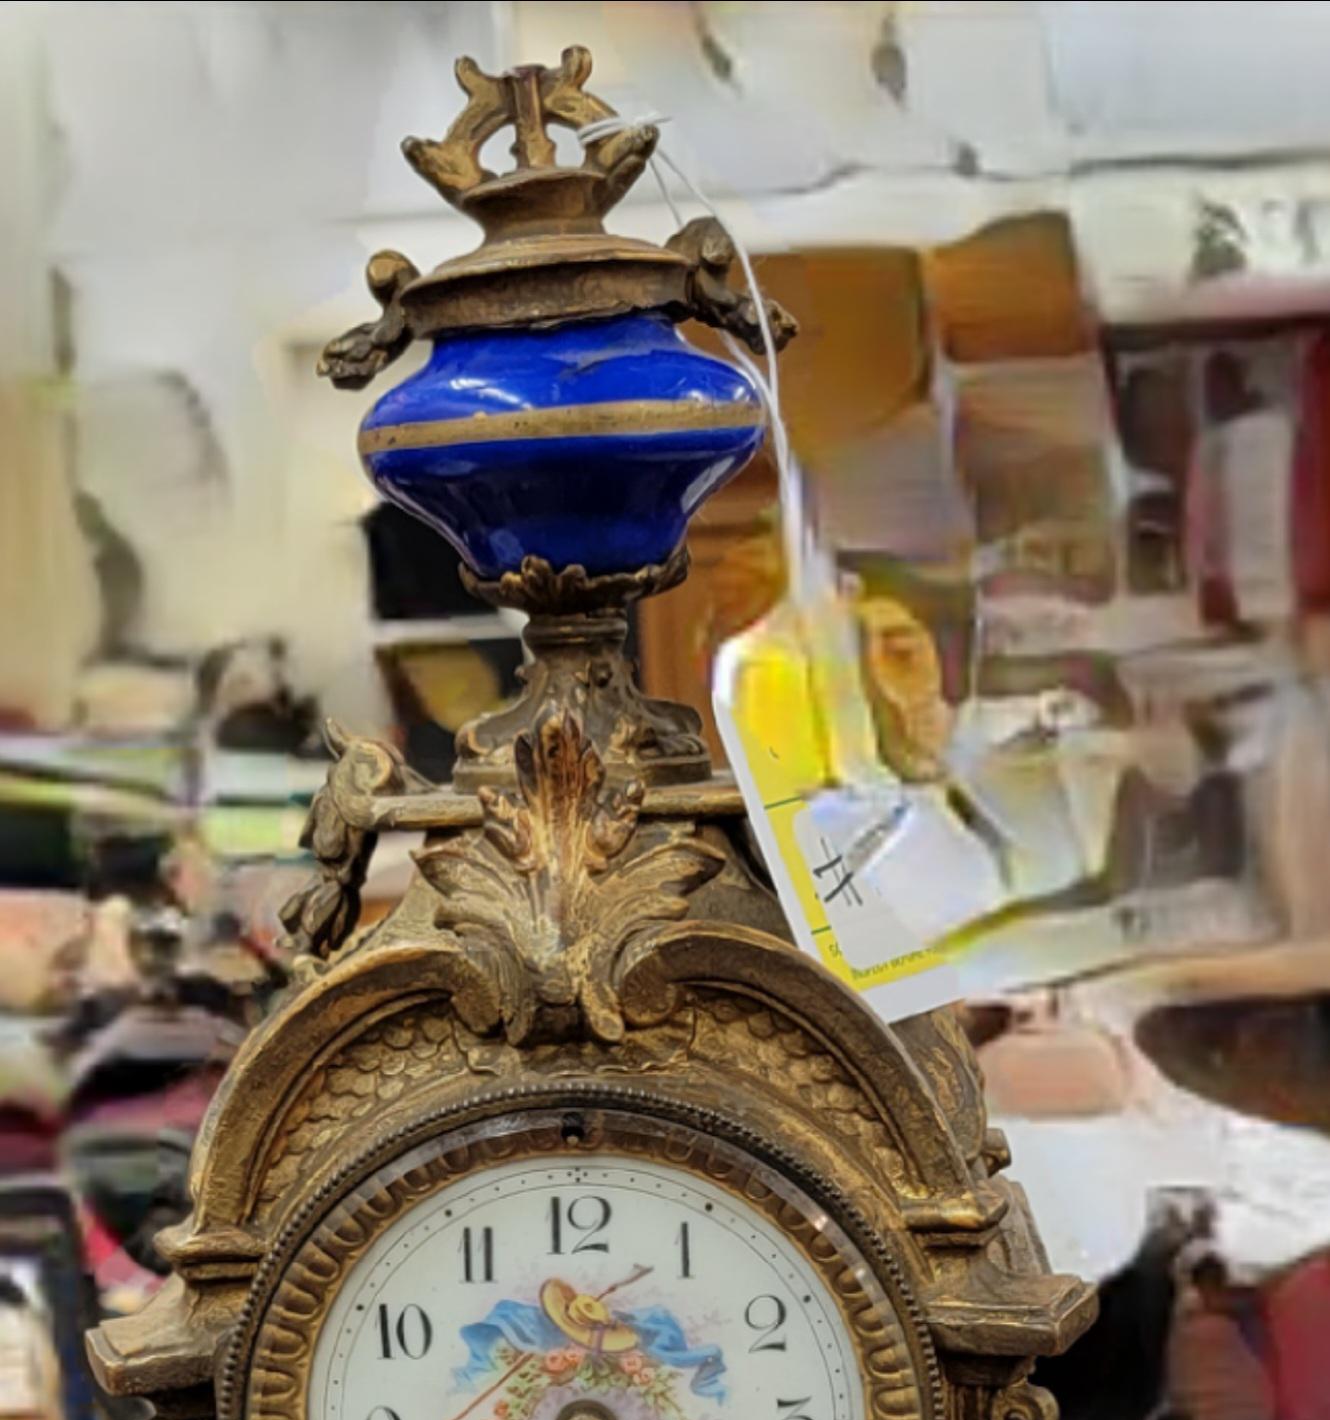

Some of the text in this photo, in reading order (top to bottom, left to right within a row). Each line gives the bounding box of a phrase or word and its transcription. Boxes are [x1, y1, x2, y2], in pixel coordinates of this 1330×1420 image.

[546, 1195, 613, 1255] 12
[677, 1221, 696, 1279] 1
[457, 1226, 499, 1284] 11
[375, 1303, 432, 1360] 10
[744, 1294, 787, 1353] 2
